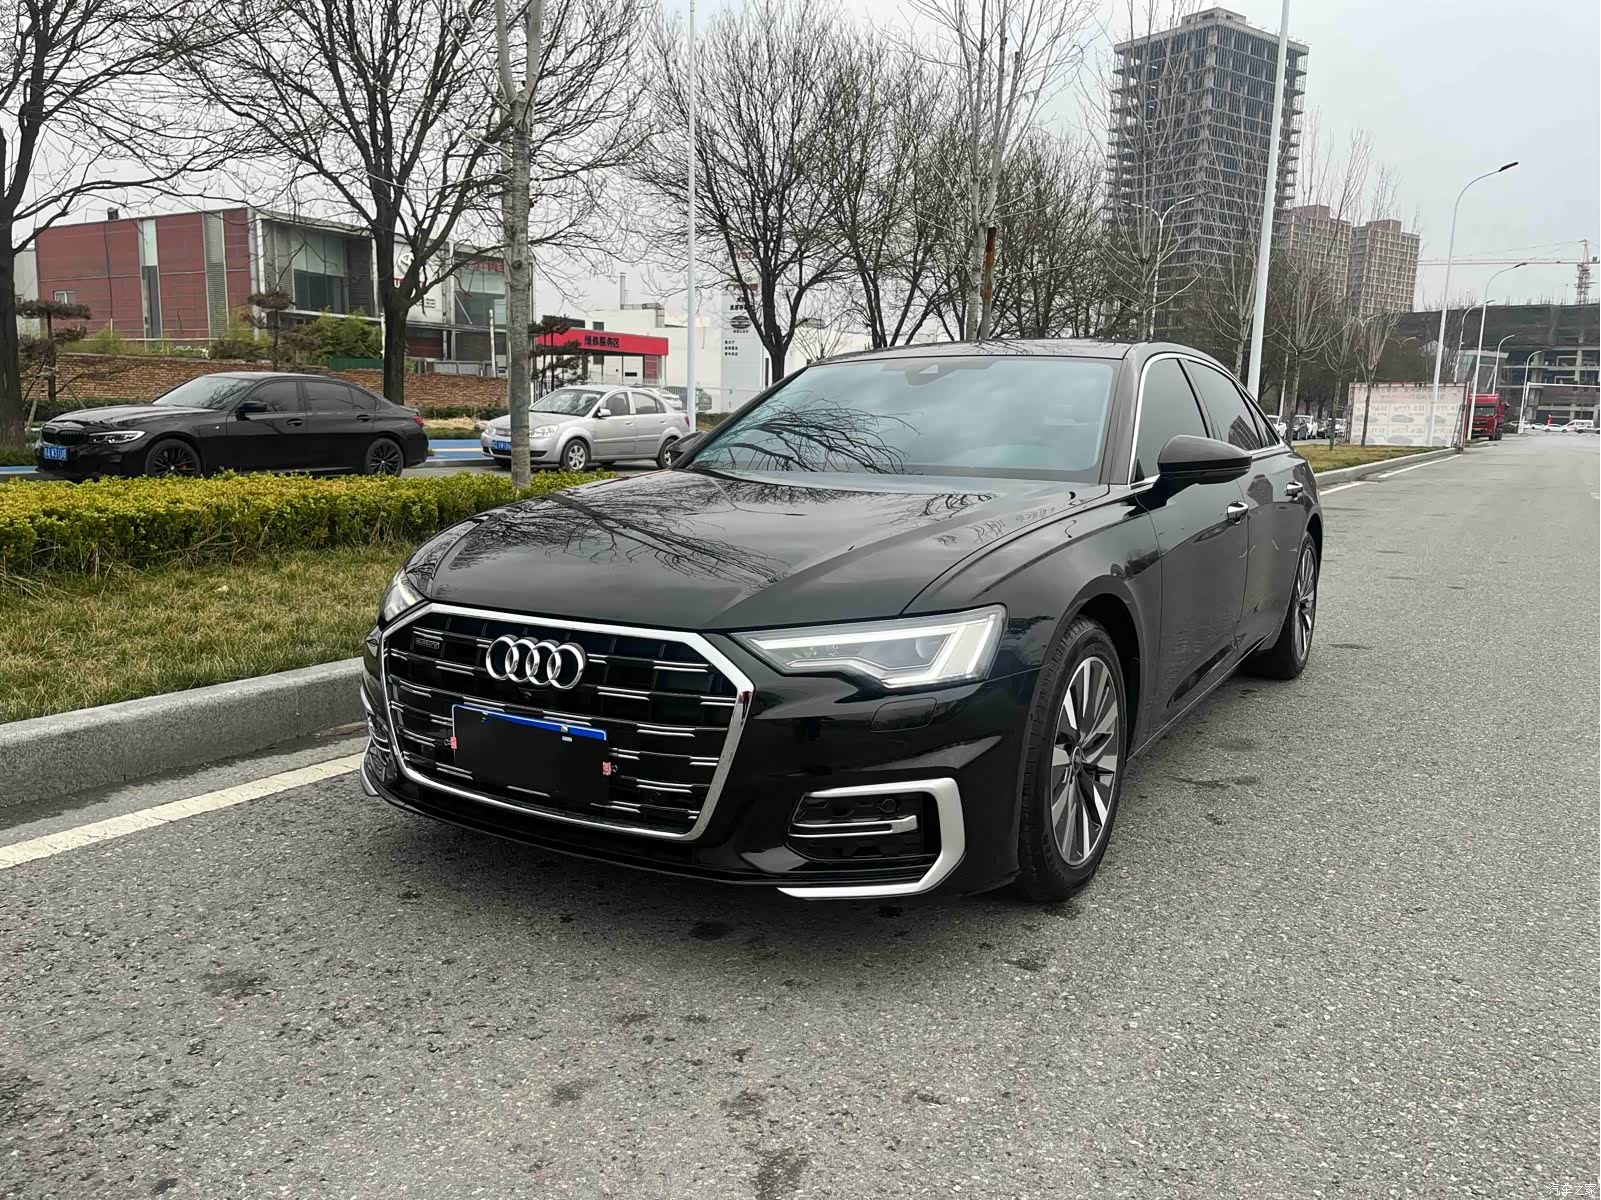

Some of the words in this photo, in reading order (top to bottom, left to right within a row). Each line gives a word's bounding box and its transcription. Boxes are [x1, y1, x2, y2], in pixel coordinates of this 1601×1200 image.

[584, 334, 620, 348] 维修服务区
